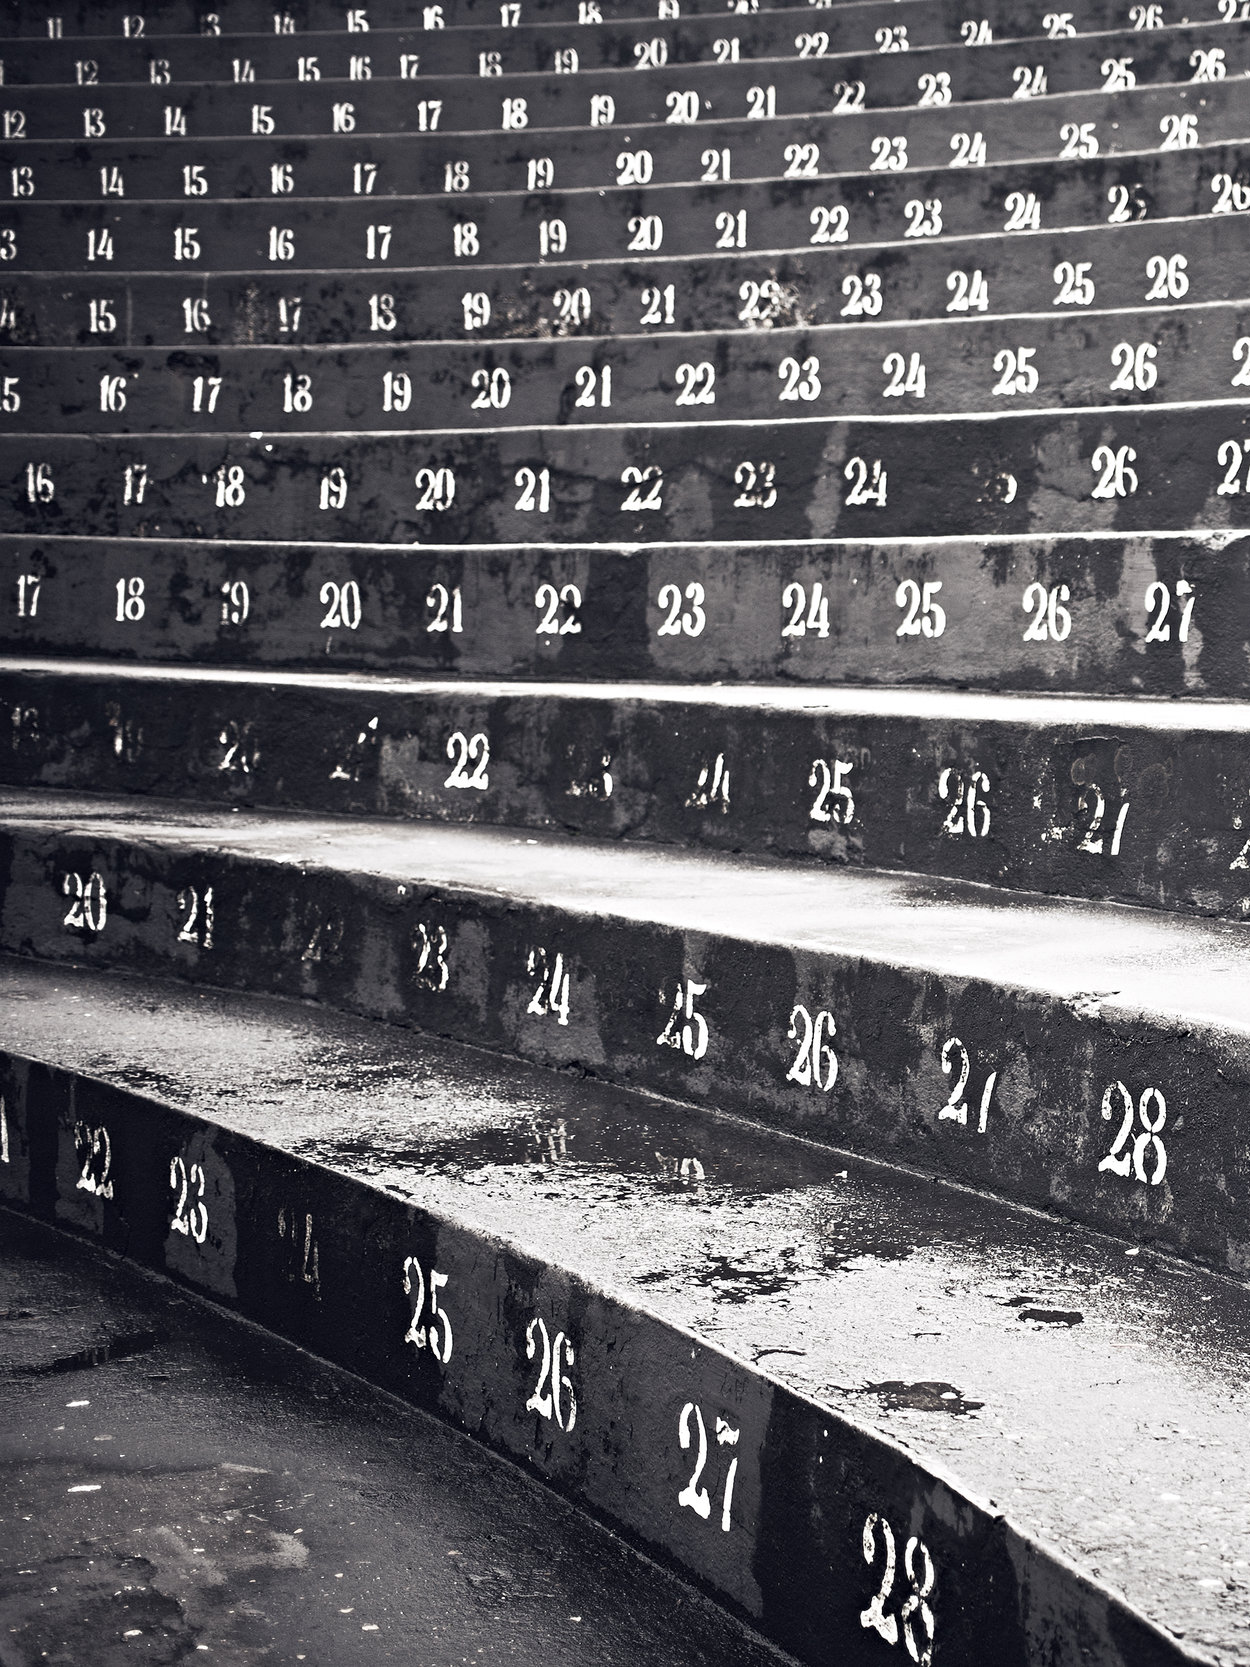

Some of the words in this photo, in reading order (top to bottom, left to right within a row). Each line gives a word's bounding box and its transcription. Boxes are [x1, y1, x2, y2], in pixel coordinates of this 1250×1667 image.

[124, 17, 144, 37] 12
[347, 10, 369, 32] 15
[423, 5, 444, 30] 16
[501, 4, 520, 27] 17
[298, 57, 320, 81] 15
[350, 57, 371, 80] 16
[400, 55, 418, 79] 17
[479, 53, 502, 77] 18
[555, 49, 578, 74] 19
[634, 39, 668, 69] 20
[713, 39, 739, 63] 21
[876, 26, 909, 53] 23
[1043, 13, 1076, 39] 25
[1130, 5, 1164, 31] 26
[4, 111, 25, 138] 12
[84, 109, 105, 137] 13
[165, 107, 186, 135] 14
[252, 105, 274, 134] 15
[333, 103, 355, 132] 16
[418, 101, 442, 131] 17
[502, 98, 528, 131] 18
[591, 95, 615, 127] 19
[665, 91, 699, 123] 20
[746, 86, 776, 119] 21
[918, 73, 952, 106] 23
[1102, 58, 1136, 91] 25
[1189, 49, 1226, 81] 26
[12, 167, 34, 196] 13
[101, 167, 123, 196] 14
[183, 166, 207, 195] 15
[271, 165, 294, 194] 16
[354, 163, 376, 194] 17
[445, 162, 469, 192] 18
[528, 158, 554, 191] 19
[616, 150, 654, 185] 20
[701, 149, 731, 181] 21
[784, 144, 820, 178] 22
[869, 136, 908, 171] 23
[949, 133, 987, 168] 24
[1060, 123, 1099, 158] 25
[1160, 114, 1199, 151] 26
[88, 229, 113, 260] 14
[174, 228, 200, 260] 15
[269, 227, 294, 260] 16
[367, 225, 391, 260] 17
[454, 222, 479, 256] 18
[540, 220, 566, 256] 19
[628, 216, 663, 250] 20
[716, 210, 746, 248] 21
[810, 205, 849, 242] 22
[904, 199, 942, 237] 23
[1004, 192, 1041, 231] 24
[90, 300, 116, 332] 15
[183, 298, 211, 332] 16
[462, 293, 490, 330] 19
[640, 284, 675, 324] 21
[840, 274, 882, 316] 23
[947, 270, 989, 312] 24
[1053, 262, 1095, 305] 25
[1145, 254, 1189, 300] 26
[100, 375, 126, 411] 16
[193, 377, 222, 413] 17
[383, 372, 411, 411] 19
[471, 368, 511, 409] 20
[575, 365, 611, 407] 21
[675, 362, 715, 406] 22
[779, 357, 821, 401] 23
[883, 352, 926, 398] 24
[992, 347, 1039, 395] 25
[1110, 342, 1157, 391] 26
[216, 466, 245, 507] 18
[319, 468, 347, 510] 19
[415, 468, 455, 511] 20
[515, 468, 549, 512] 21
[621, 467, 663, 511] 22
[844, 457, 887, 506] 24
[1091, 445, 1138, 498] 26
[18, 575, 40, 616] 17
[116, 577, 145, 621] 18
[320, 581, 361, 629] 20
[427, 584, 463, 632] 21
[535, 584, 581, 635] 22
[657, 582, 705, 637] 23
[782, 582, 830, 638] 24
[896, 579, 946, 638] 25
[1022, 582, 1071, 641] 26
[1145, 580, 1196, 643] 27
[444, 732, 489, 790] 22
[809, 759, 854, 823] 25
[938, 768, 990, 836] 26
[64, 873, 107, 930] 20
[527, 948, 570, 1025] 24
[657, 979, 709, 1060] 25
[786, 1005, 838, 1091] 26
[1098, 1081, 1167, 1185] 28
[170, 1157, 208, 1243] 23
[403, 1257, 453, 1363] 25
[526, 1318, 576, 1432] 26
[678, 1403, 739, 1531] 27
[860, 1513, 934, 1667] 28
